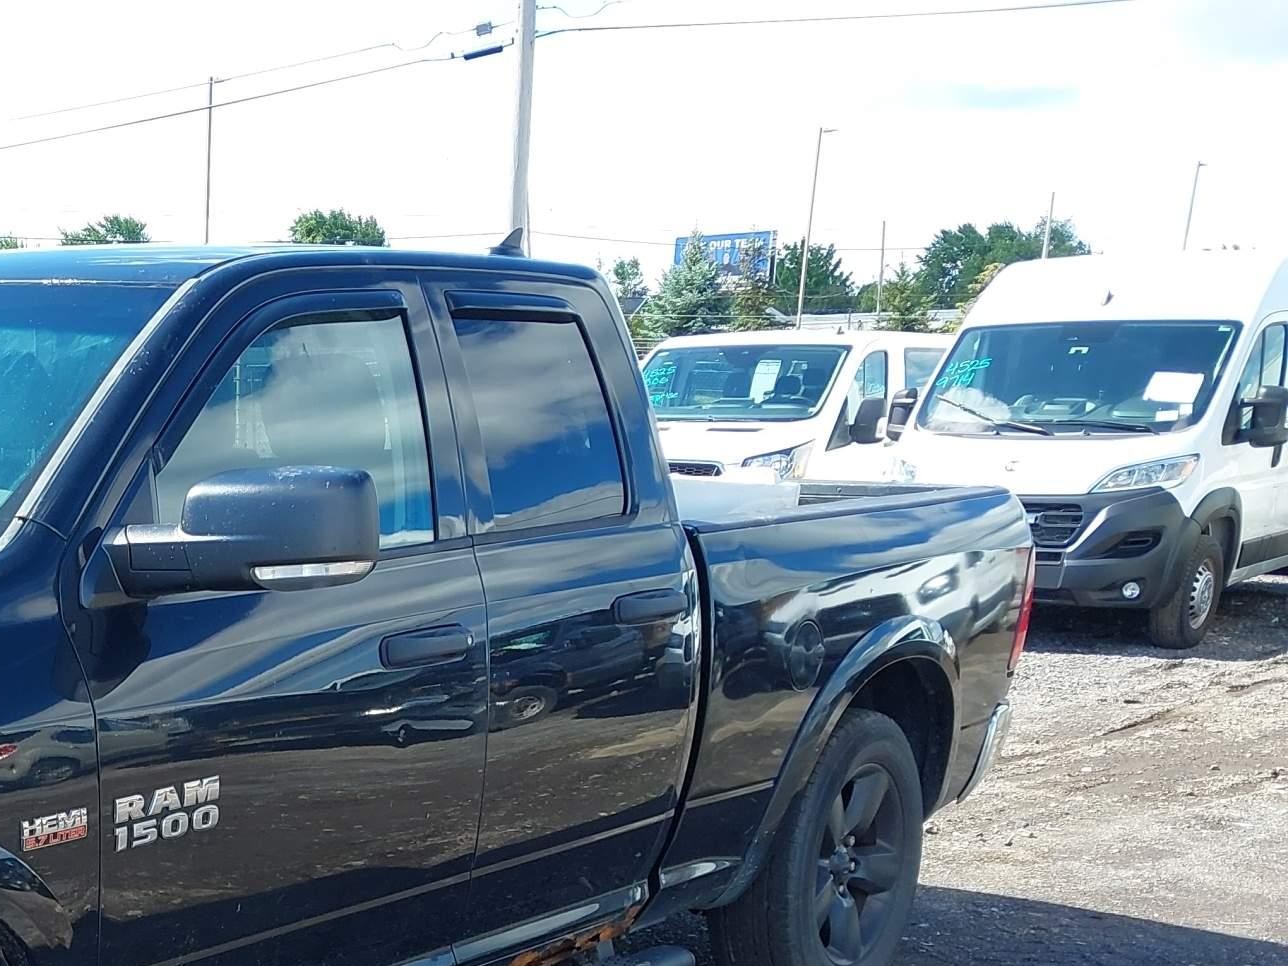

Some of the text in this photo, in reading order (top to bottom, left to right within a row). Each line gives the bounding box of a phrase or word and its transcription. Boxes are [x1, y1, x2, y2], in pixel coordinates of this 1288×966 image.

[115, 775, 221, 824] RAM
[22, 807, 88, 838] HEMI
[25, 826, 86, 849] 5.7 LITER
[115, 804, 221, 853] 1500
